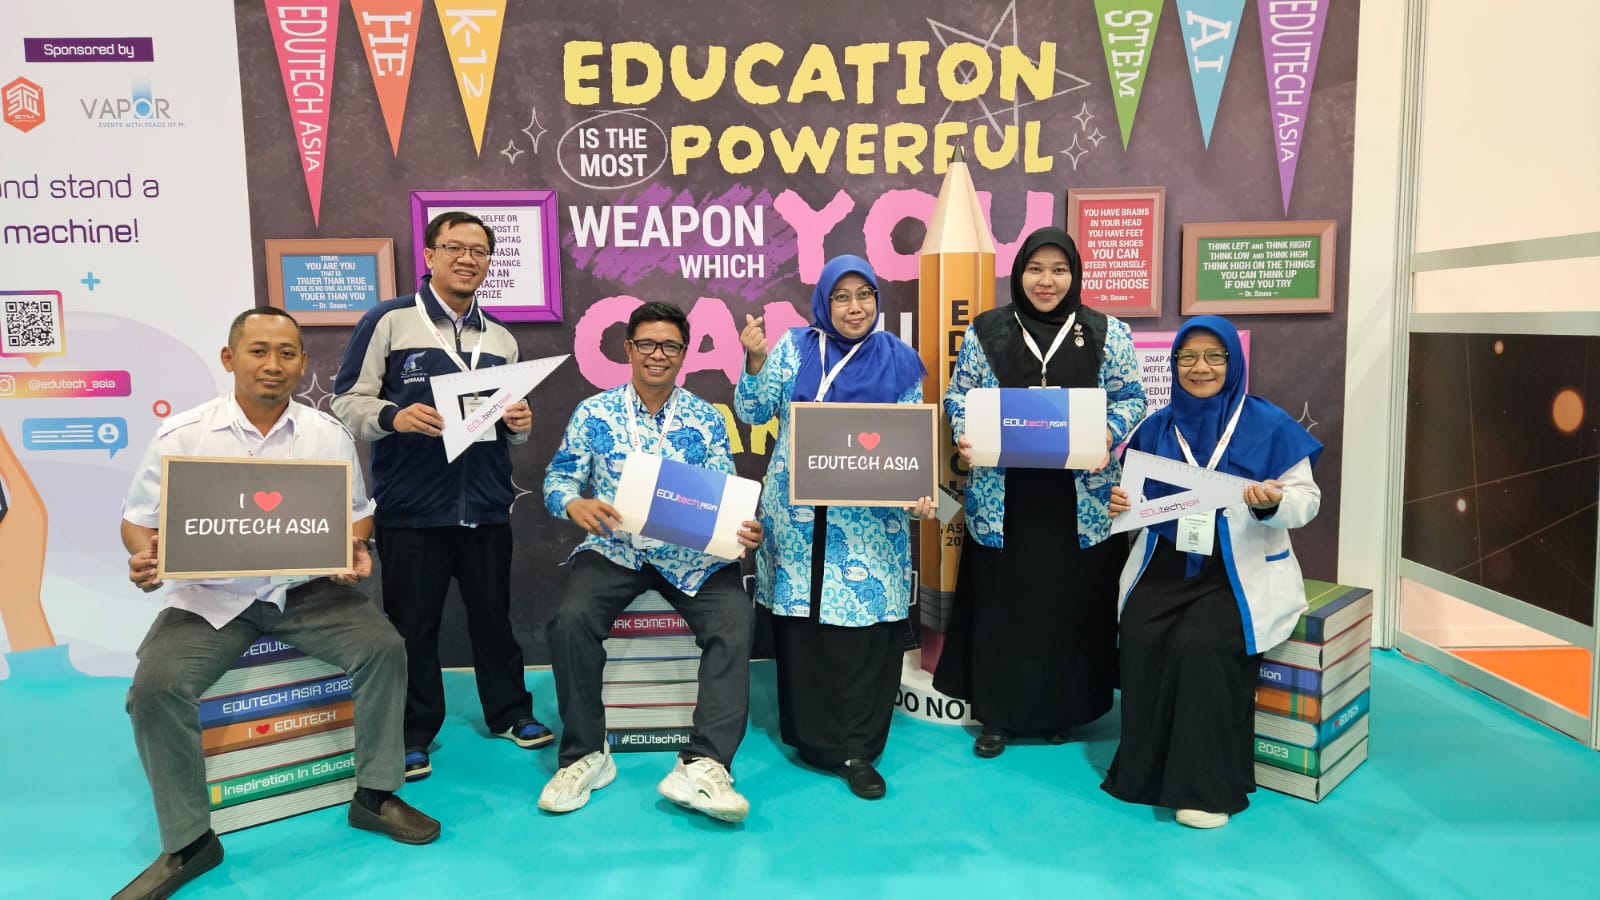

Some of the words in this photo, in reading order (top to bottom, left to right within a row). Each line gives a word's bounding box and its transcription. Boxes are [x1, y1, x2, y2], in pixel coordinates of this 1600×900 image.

[362, 11, 412, 77] HE
[1186, 10, 1232, 73] AI
[44, 43, 115, 57] Sponsored
[118, 43, 135, 59] by
[445, 9, 497, 99] K-12
[1104, 10, 1154, 98] STEM
[1268, 0, 1318, 106] EDUTECH
[278, 6, 328, 114] EDUTECH
[564, 39, 1057, 106] EDUCATION
[80, 98, 170, 119] VAPOR
[579, 128, 600, 149] IS
[605, 128, 647, 149] THE
[1277, 112, 1300, 163] ASIA
[299, 120, 322, 172] ASIA
[670, 120, 1054, 175] POWERFUL
[580, 154, 648, 177] MOST
[0, 174, 39, 199] nd
[50, 173, 132, 199] stand
[143, 179, 160, 199] a
[481, 214, 506, 222] SELFIE
[507, 214, 518, 222] OR
[1084, 209, 1099, 217] YOU
[1122, 208, 1150, 216] BRAINS
[4, 218, 139, 244] machine!
[492, 225, 511, 233] POST
[513, 225, 520, 233] IT
[569, 204, 764, 248] WEAPON
[1091, 219, 1098, 227] IN
[1100, 219, 1120, 227] YOUR
[773, 188, 1055, 285] YOU
[1105, 229, 1124, 237] HAVE
[1126, 229, 1144, 237] FEET
[1088, 240, 1095, 248] IN
[1097, 240, 1117, 248] YOUR
[1208, 242, 1231, 251] THINK
[1232, 242, 1250, 250] LEFT
[1265, 241, 1288, 249] THINK
[1290, 240, 1312, 249] RIGHT
[1092, 249, 1114, 259] YOU
[1117, 249, 1139, 259] CAN
[1210, 252, 1232, 260] THINK
[1233, 252, 1250, 260] LOW
[1266, 251, 1288, 259] THINK
[1290, 250, 1308, 258] HIGH
[305, 262, 321, 270] YOU
[323, 262, 339, 270] ARE
[340, 262, 356, 270] YOU
[679, 254, 765, 279] WHICH
[1084, 261, 1107, 269] STEER
[1109, 260, 1146, 268] YOURSELF
[1203, 262, 1229, 271] THINK
[1230, 261, 1251, 270] HIGH
[1253, 261, 1265, 269] ON
[1267, 260, 1283, 269] THE
[1285, 260, 1316, 269] THINGS
[296, 277, 321, 285] TRUER
[324, 277, 344, 285] THAN
[346, 276, 366, 285] TRUE
[497, 269, 510, 277] AN
[1092, 270, 1107, 278] ANY
[1109, 270, 1147, 278] DIRECTION
[1221, 271, 1238, 280] YOU
[1239, 271, 1257, 279] CAN
[1259, 270, 1284, 279] THINK
[1286, 270, 1297, 278] UP
[1081, 279, 1102, 290] YOU
[1105, 279, 1149, 289] CHOOSE
[1225, 280, 1232, 289] IF
[1234, 280, 1256, 289] ONLY
[1258, 280, 1275, 288] YOU
[1276, 279, 1292, 287] TRY
[300, 293, 325, 301] YOUER
[327, 292, 348, 300] THAN
[350, 292, 365, 300] YOU
[476, 290, 502, 299] PRIZE
[1145, 355, 1165, 363] SNAP
[1142, 365, 1165, 373] WEFIE
[28, 378, 116, 392] @edutech_asia
[847, 433, 852, 448] I
[808, 455, 880, 470] EDUTECH
[883, 456, 919, 471] ASIA
[239, 493, 245, 509] I
[185, 518, 281, 536] EDUTECH
[285, 518, 330, 535] ASIA
[241, 640, 294, 657] EDUte
[223, 690, 288, 715] EDUTECH
[291, 683, 323, 701] ASIA
[325, 677, 353, 694] 2023
[248, 726, 252, 739] I
[274, 709, 337, 732] EDUTECH
[621, 733, 690, 745] #EDUtechAsi
[1258, 741, 1289, 759] 2023
[224, 770, 294, 798] Inspiration
[297, 766, 309, 779] In
